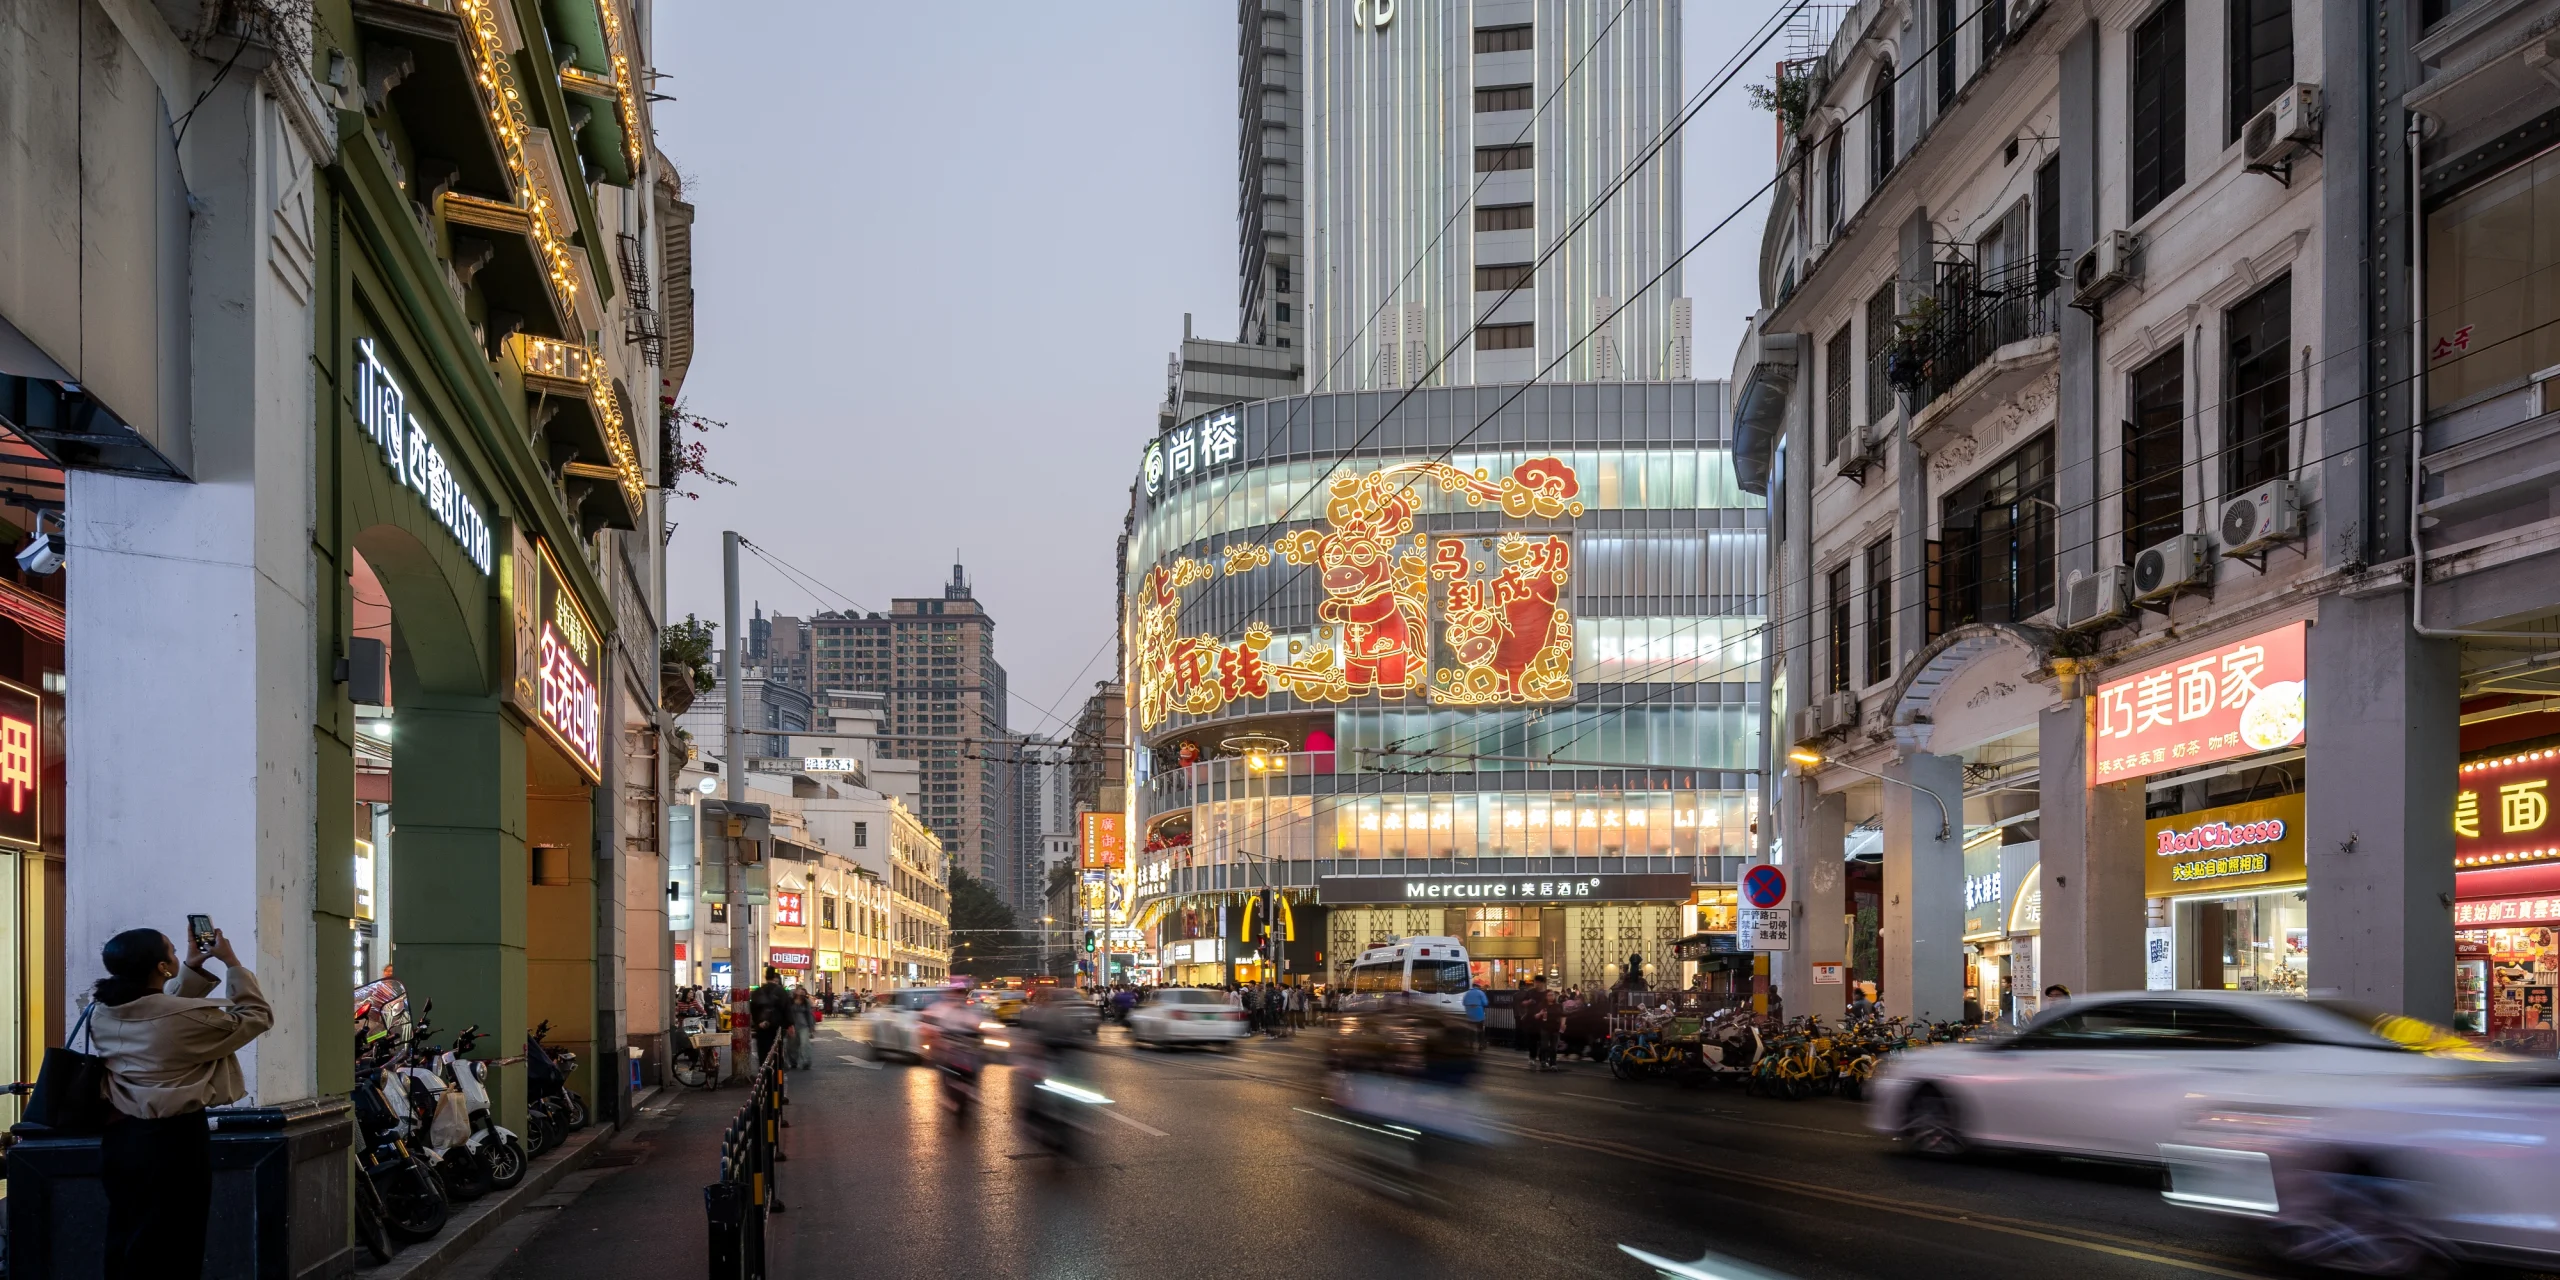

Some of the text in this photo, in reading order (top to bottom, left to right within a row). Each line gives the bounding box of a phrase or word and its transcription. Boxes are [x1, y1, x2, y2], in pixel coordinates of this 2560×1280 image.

[2431, 325, 2473, 361] 소주
[1169, 413, 1238, 482] 尚榕
[409, 413, 445, 523] 西餐
[445, 469, 491, 577] BISTRO
[1168, 637, 1269, 703] 有钱
[2099, 644, 2266, 739] 巧美面家
[540, 620, 600, 768] 名表回收
[2098, 731, 2240, 775] 港式云吞面 奶茶 咖啡
[2173, 854, 2266, 880] 大头贴自助照相馆
[1407, 882, 1589, 897] Mercure 美居酒店
[1741, 920, 1788, 930] 禁止一切停
[772, 952, 810, 965] 中国回力
